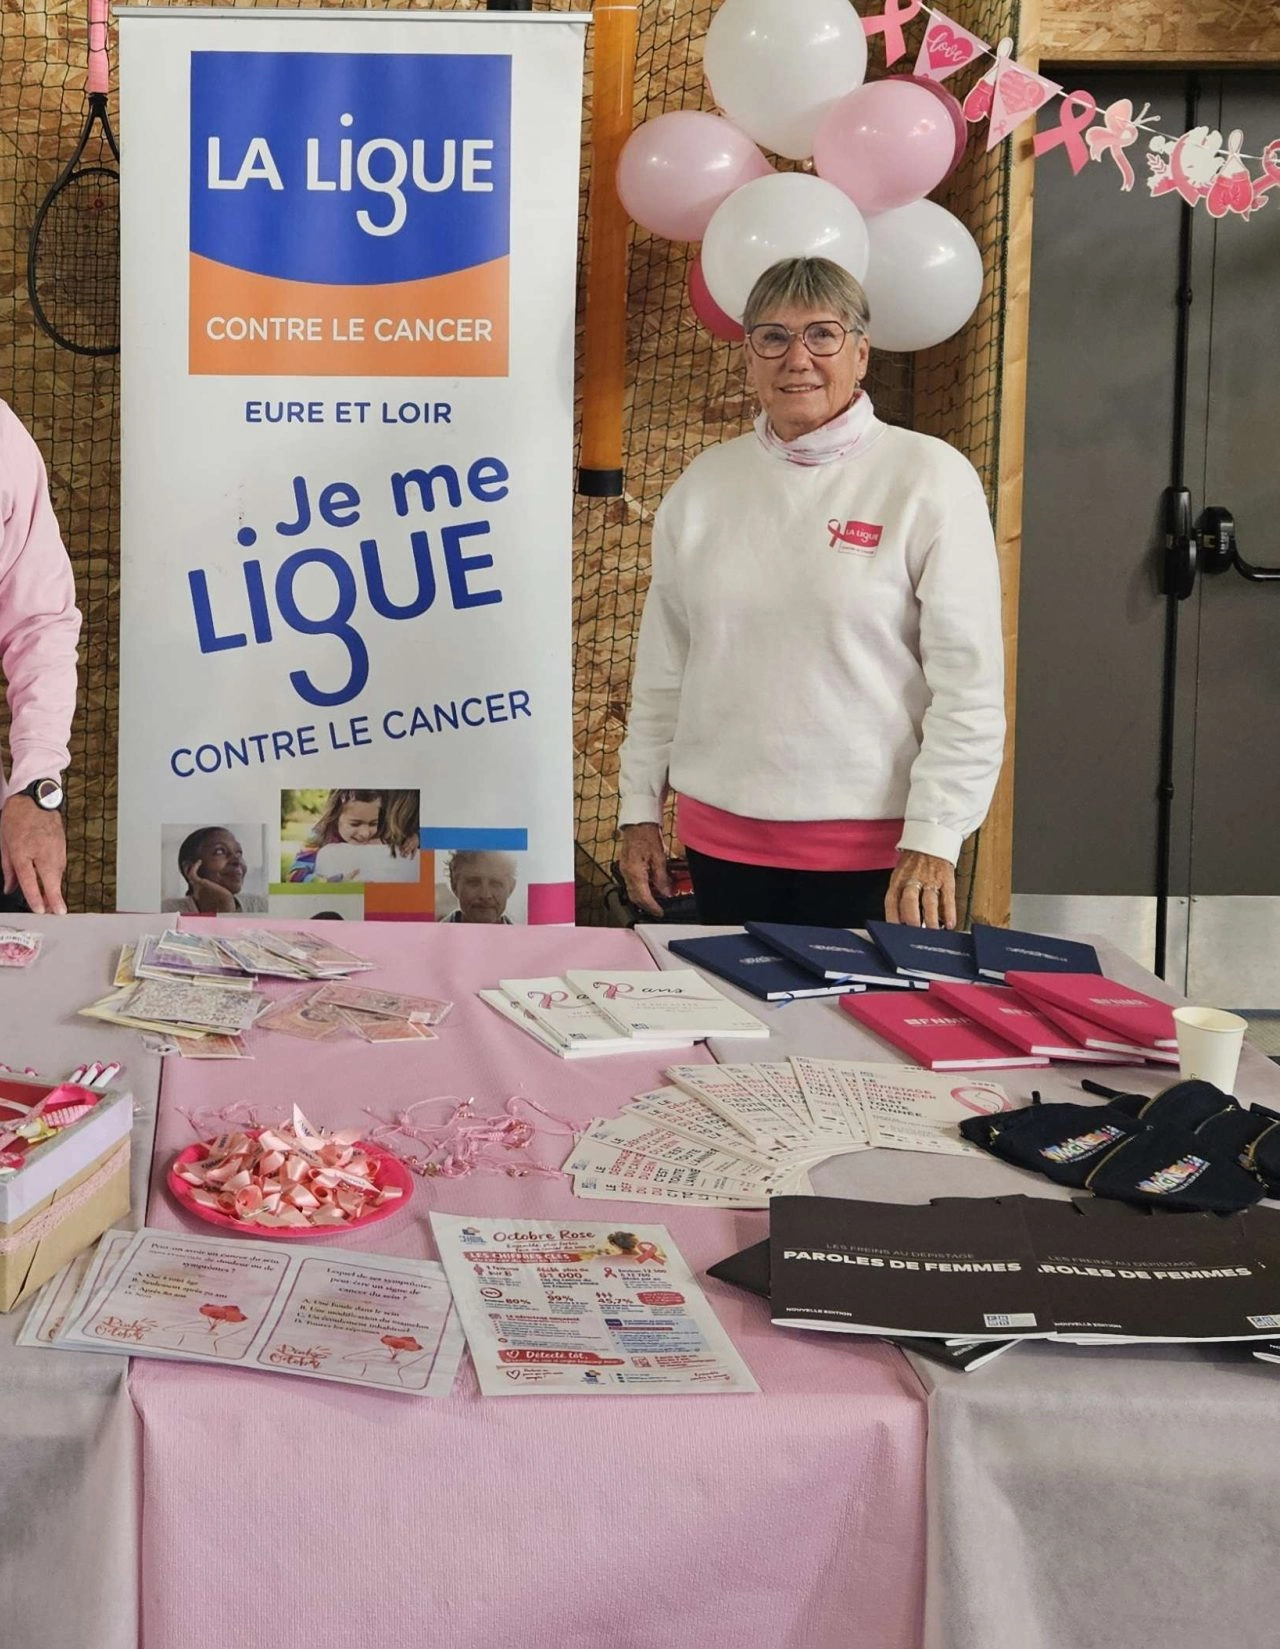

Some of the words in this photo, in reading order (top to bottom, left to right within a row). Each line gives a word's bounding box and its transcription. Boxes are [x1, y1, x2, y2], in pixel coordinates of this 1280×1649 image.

[928, 32, 969, 62] love
[207, 136, 285, 191] LA
[206, 317, 322, 342] CONTRE
[332, 318, 365, 342] LE
[374, 318, 493, 342] CANCER
[245, 401, 324, 424] EURE
[335, 402, 372, 424] ET
[382, 402, 452, 425] LOIR
[276, 475, 361, 537] Je
[391, 456, 510, 517] me
[170, 725, 319, 778] CONTRE
[328, 716, 373, 751] LE
[382, 689, 533, 741] CANCER
[493, 1231, 555, 1242] Octobre
[560, 1229, 595, 1240] Rose
[783, 1250, 885, 1268] PAROLES
[889, 1259, 920, 1271] DE
[924, 1262, 1022, 1273] FEMMES
[1118, 1270, 1151, 1280] DE
[1154, 1267, 1253, 1280] FEMMES
